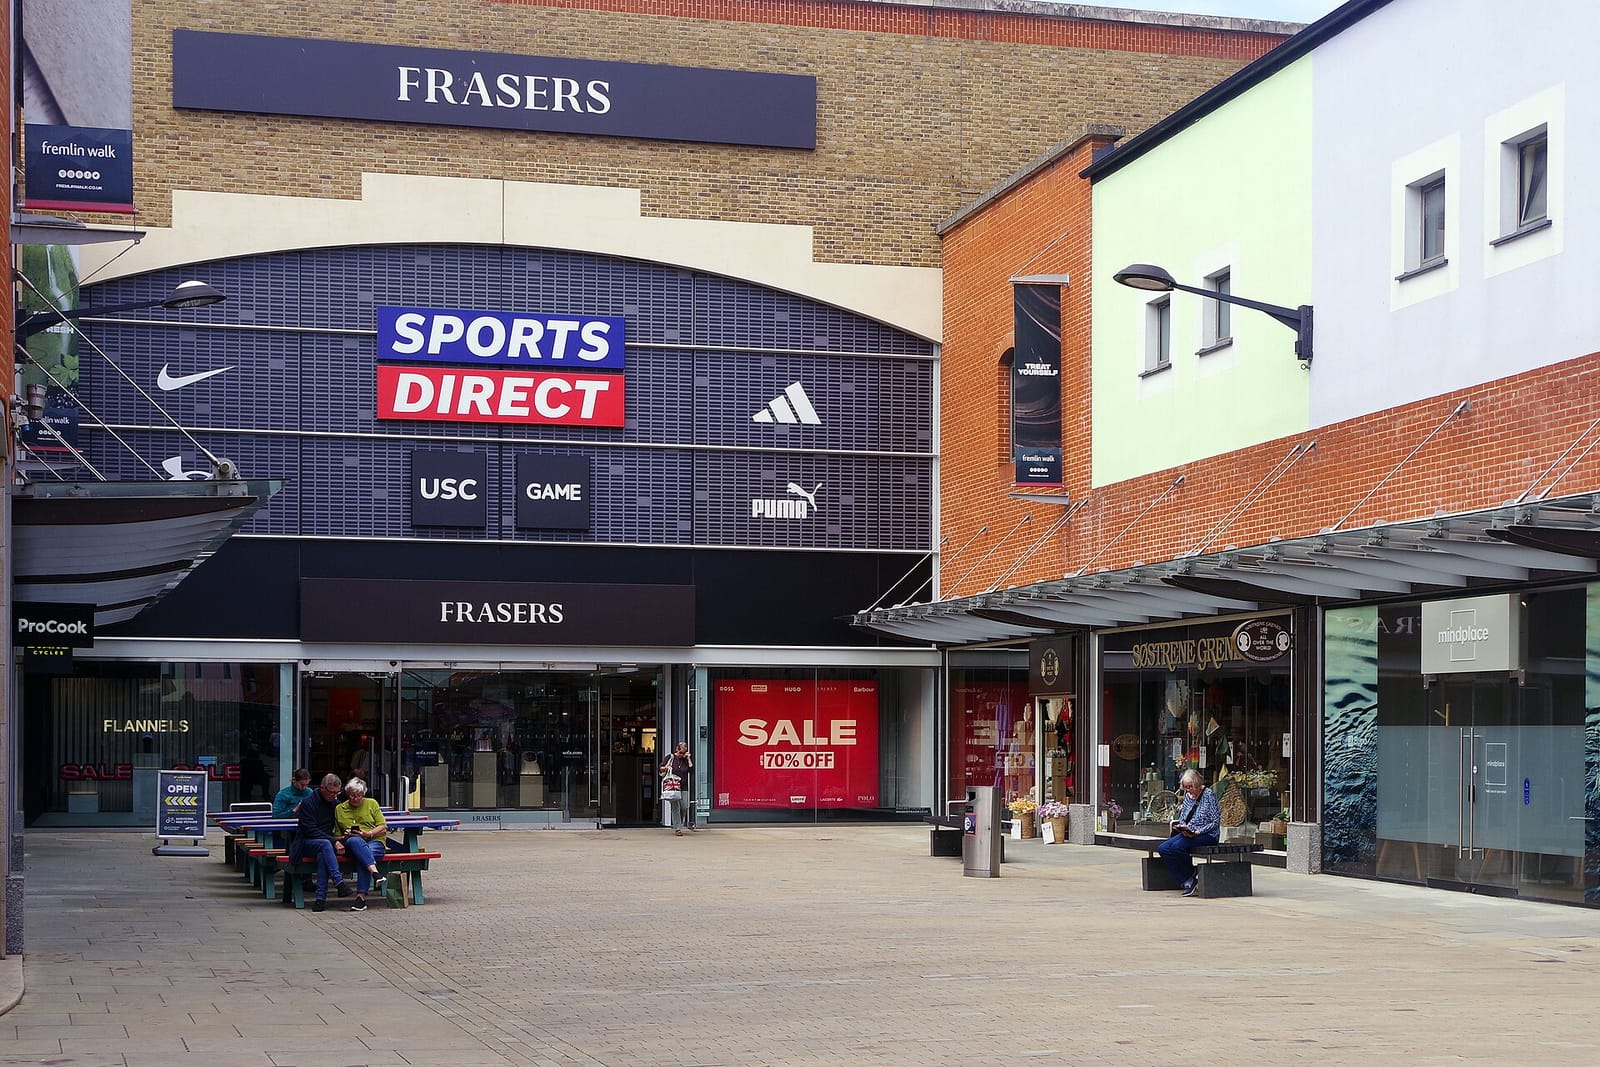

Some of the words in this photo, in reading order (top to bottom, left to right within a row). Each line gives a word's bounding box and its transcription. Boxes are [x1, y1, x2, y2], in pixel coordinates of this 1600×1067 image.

[397, 66, 612, 115] FRASERS
[42, 141, 85, 156] fremlin
[87, 145, 116, 158] walk
[391, 312, 611, 362] SPORTS
[392, 373, 610, 419] DIRECT
[1042, 454, 1055, 462] walk
[420, 477, 478, 500] USC
[526, 482, 582, 501] GAME
[751, 498, 808, 520] PUMA
[440, 601, 564, 624] FRASERS
[18, 618, 88, 635] ProCook
[1438, 625, 1489, 645] mindplace
[1132, 639, 1196, 672] SØSTRENE
[103, 719, 189, 733] FLANNELS
[737, 718, 857, 747] SALE
[765, 753, 800, 767] 70%
[803, 753, 833, 767] OFF
[60, 763, 133, 781] SALE
[167, 785, 198, 793] OPEN
